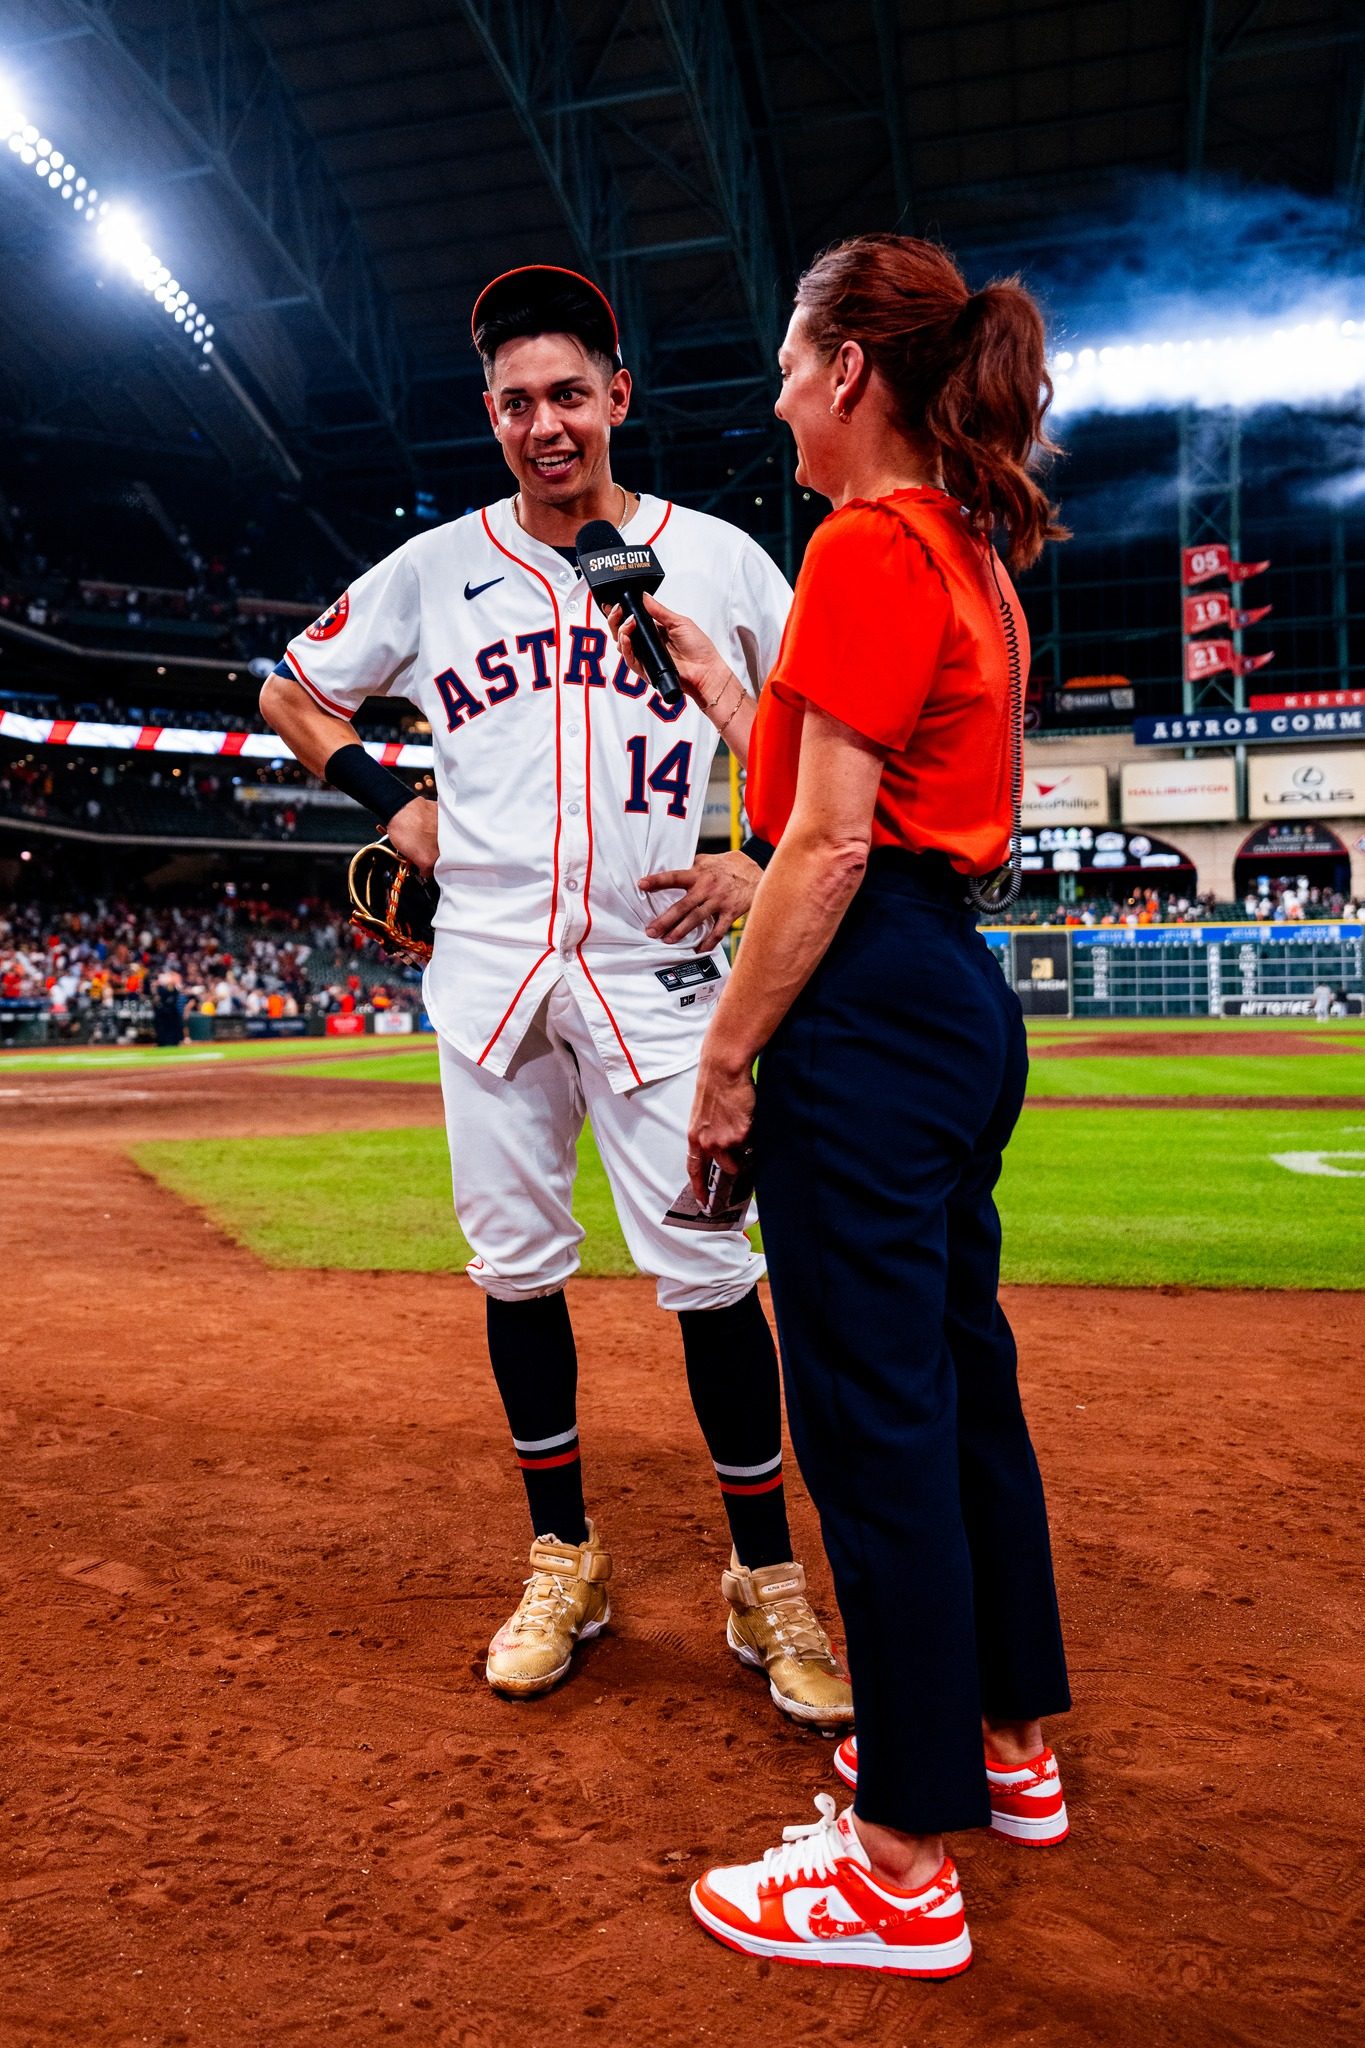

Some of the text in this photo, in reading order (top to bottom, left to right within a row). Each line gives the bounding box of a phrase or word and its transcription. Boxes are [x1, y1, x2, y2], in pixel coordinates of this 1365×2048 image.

[589, 551, 650, 572] SPACE CITY
[628, 561, 651, 570] NETWORK
[1195, 600, 1220, 624] 19
[1194, 646, 1219, 668] 21
[1153, 711, 1362, 739] ASTROS COMM
[624, 735, 693, 819] 14
[1128, 784, 1229, 797] HALLIBURTON
[1264, 788, 1355, 805] LEXUS
